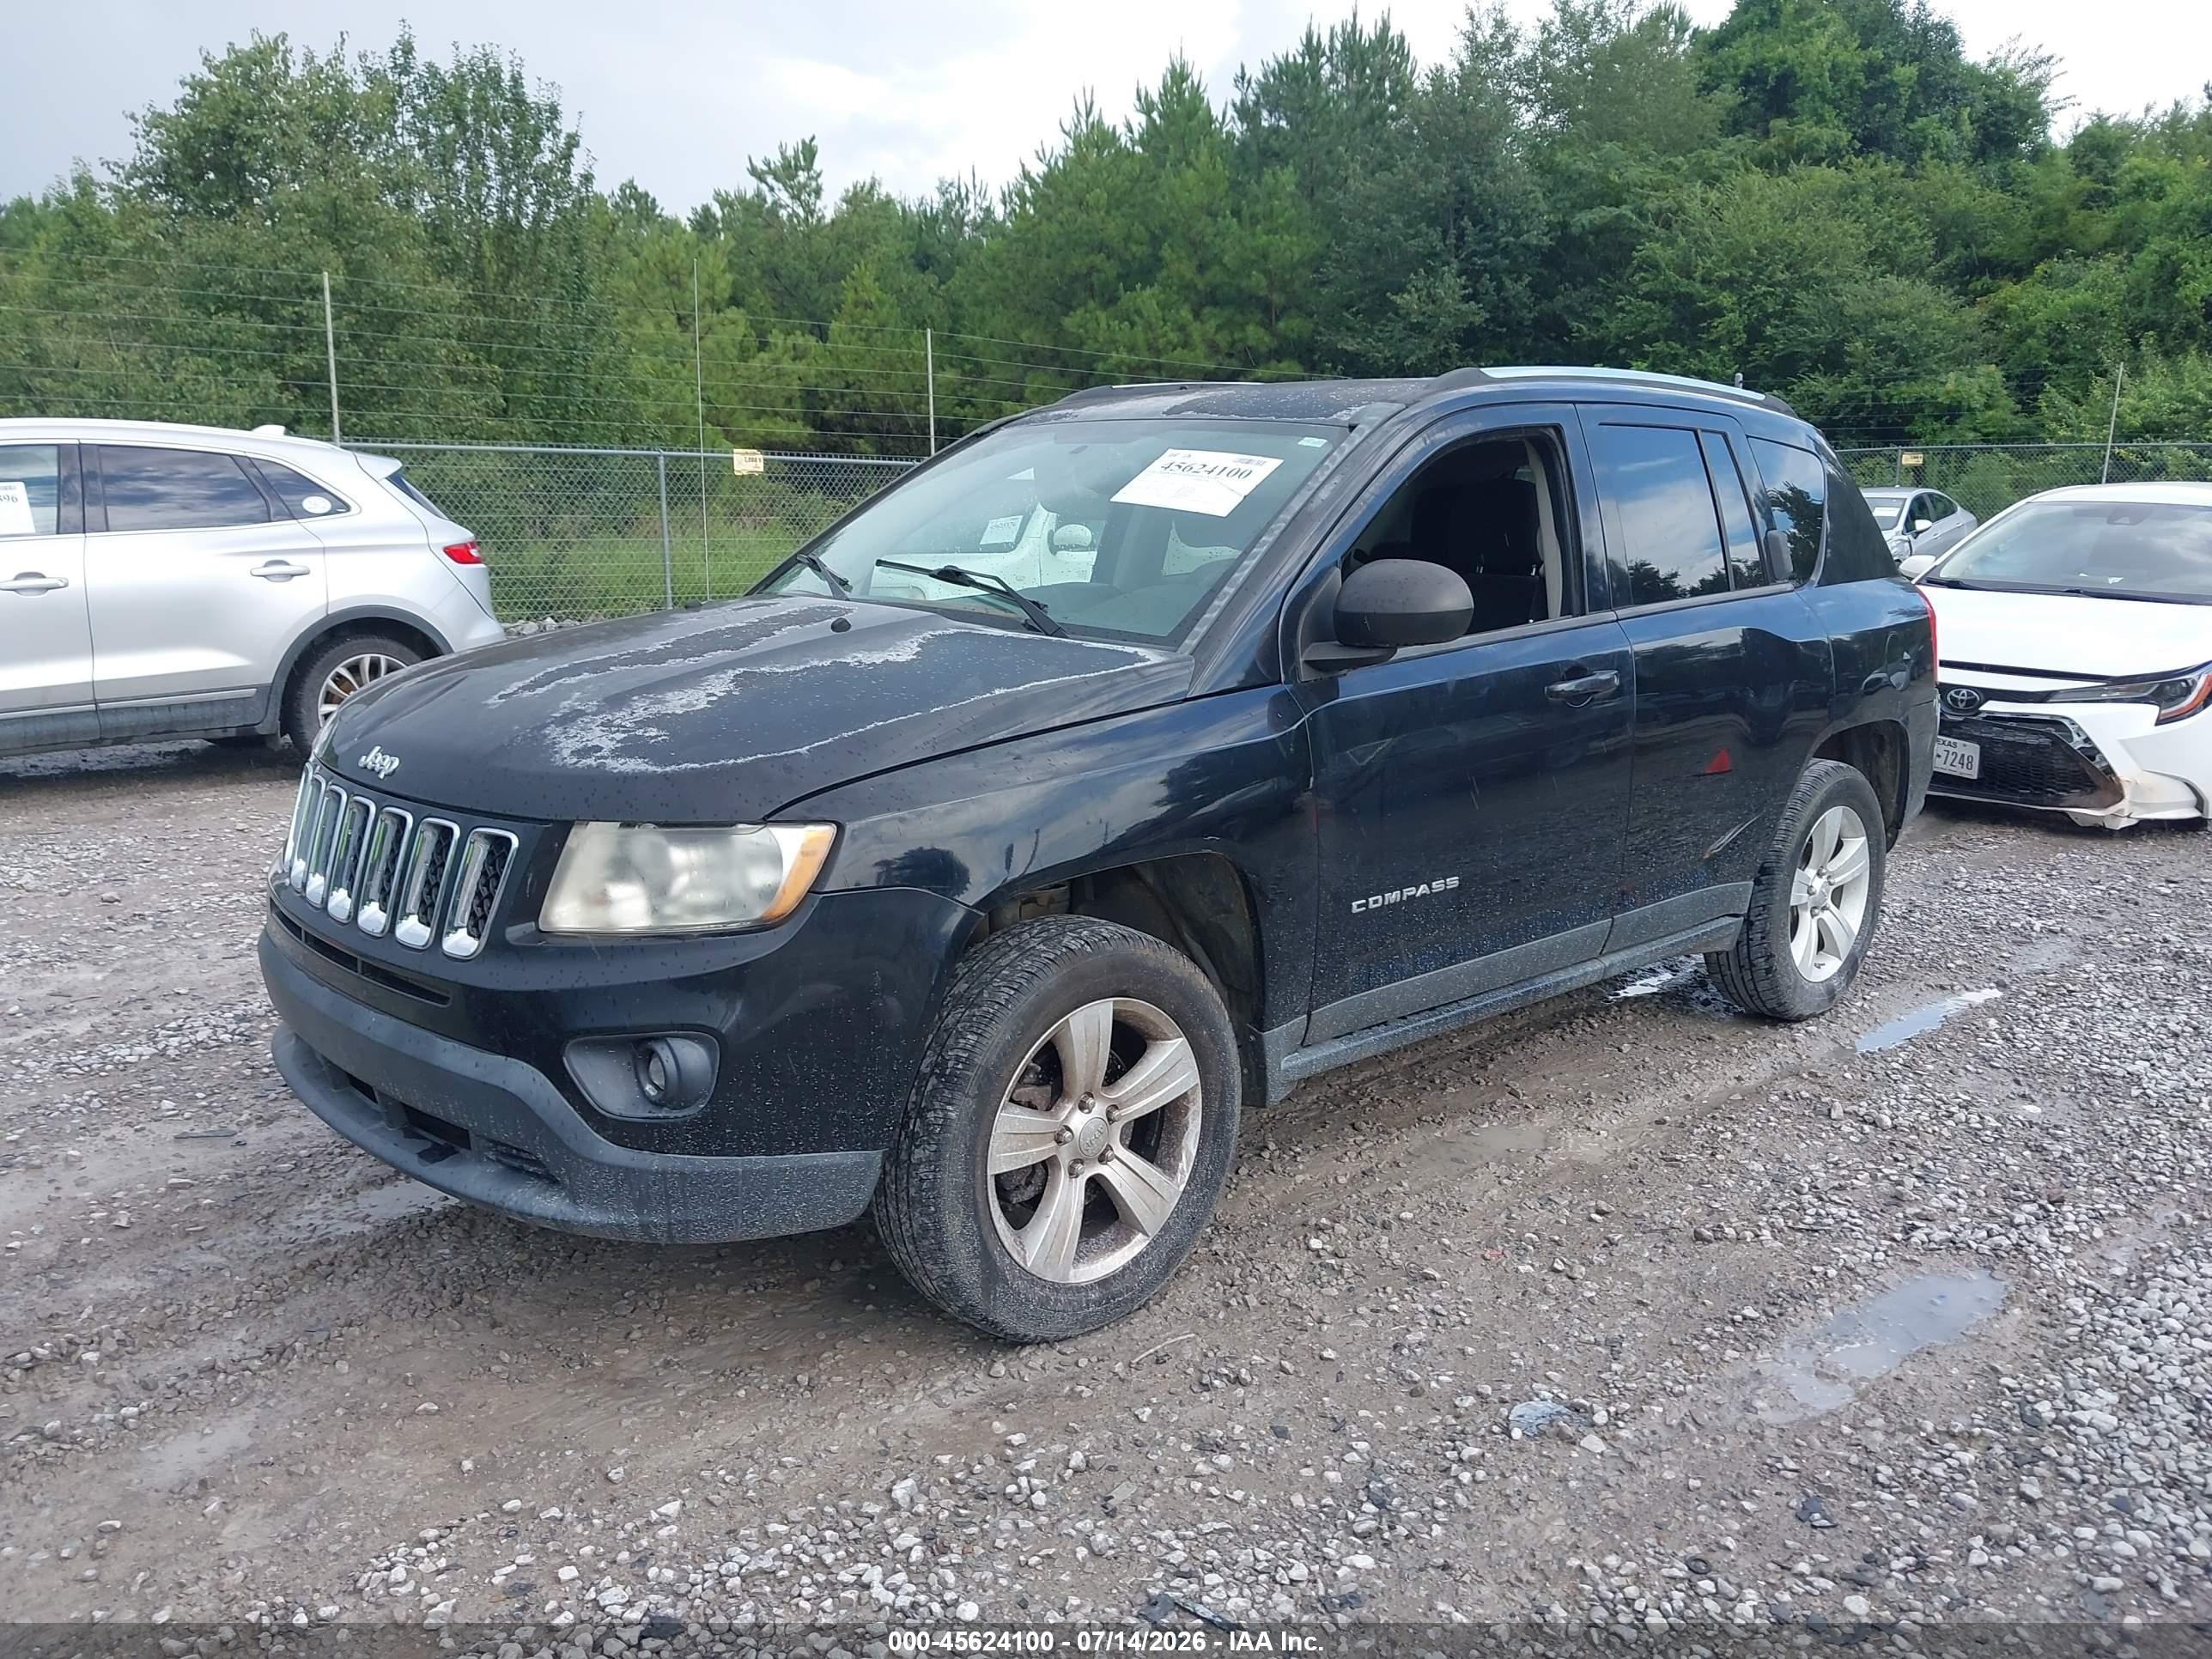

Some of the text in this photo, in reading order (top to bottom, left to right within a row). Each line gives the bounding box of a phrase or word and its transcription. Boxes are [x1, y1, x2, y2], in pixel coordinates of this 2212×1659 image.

[1160, 461, 1253, 479] 45624100
[357, 744, 400, 780] Jeep
[1351, 876, 1460, 914] COMPASS
